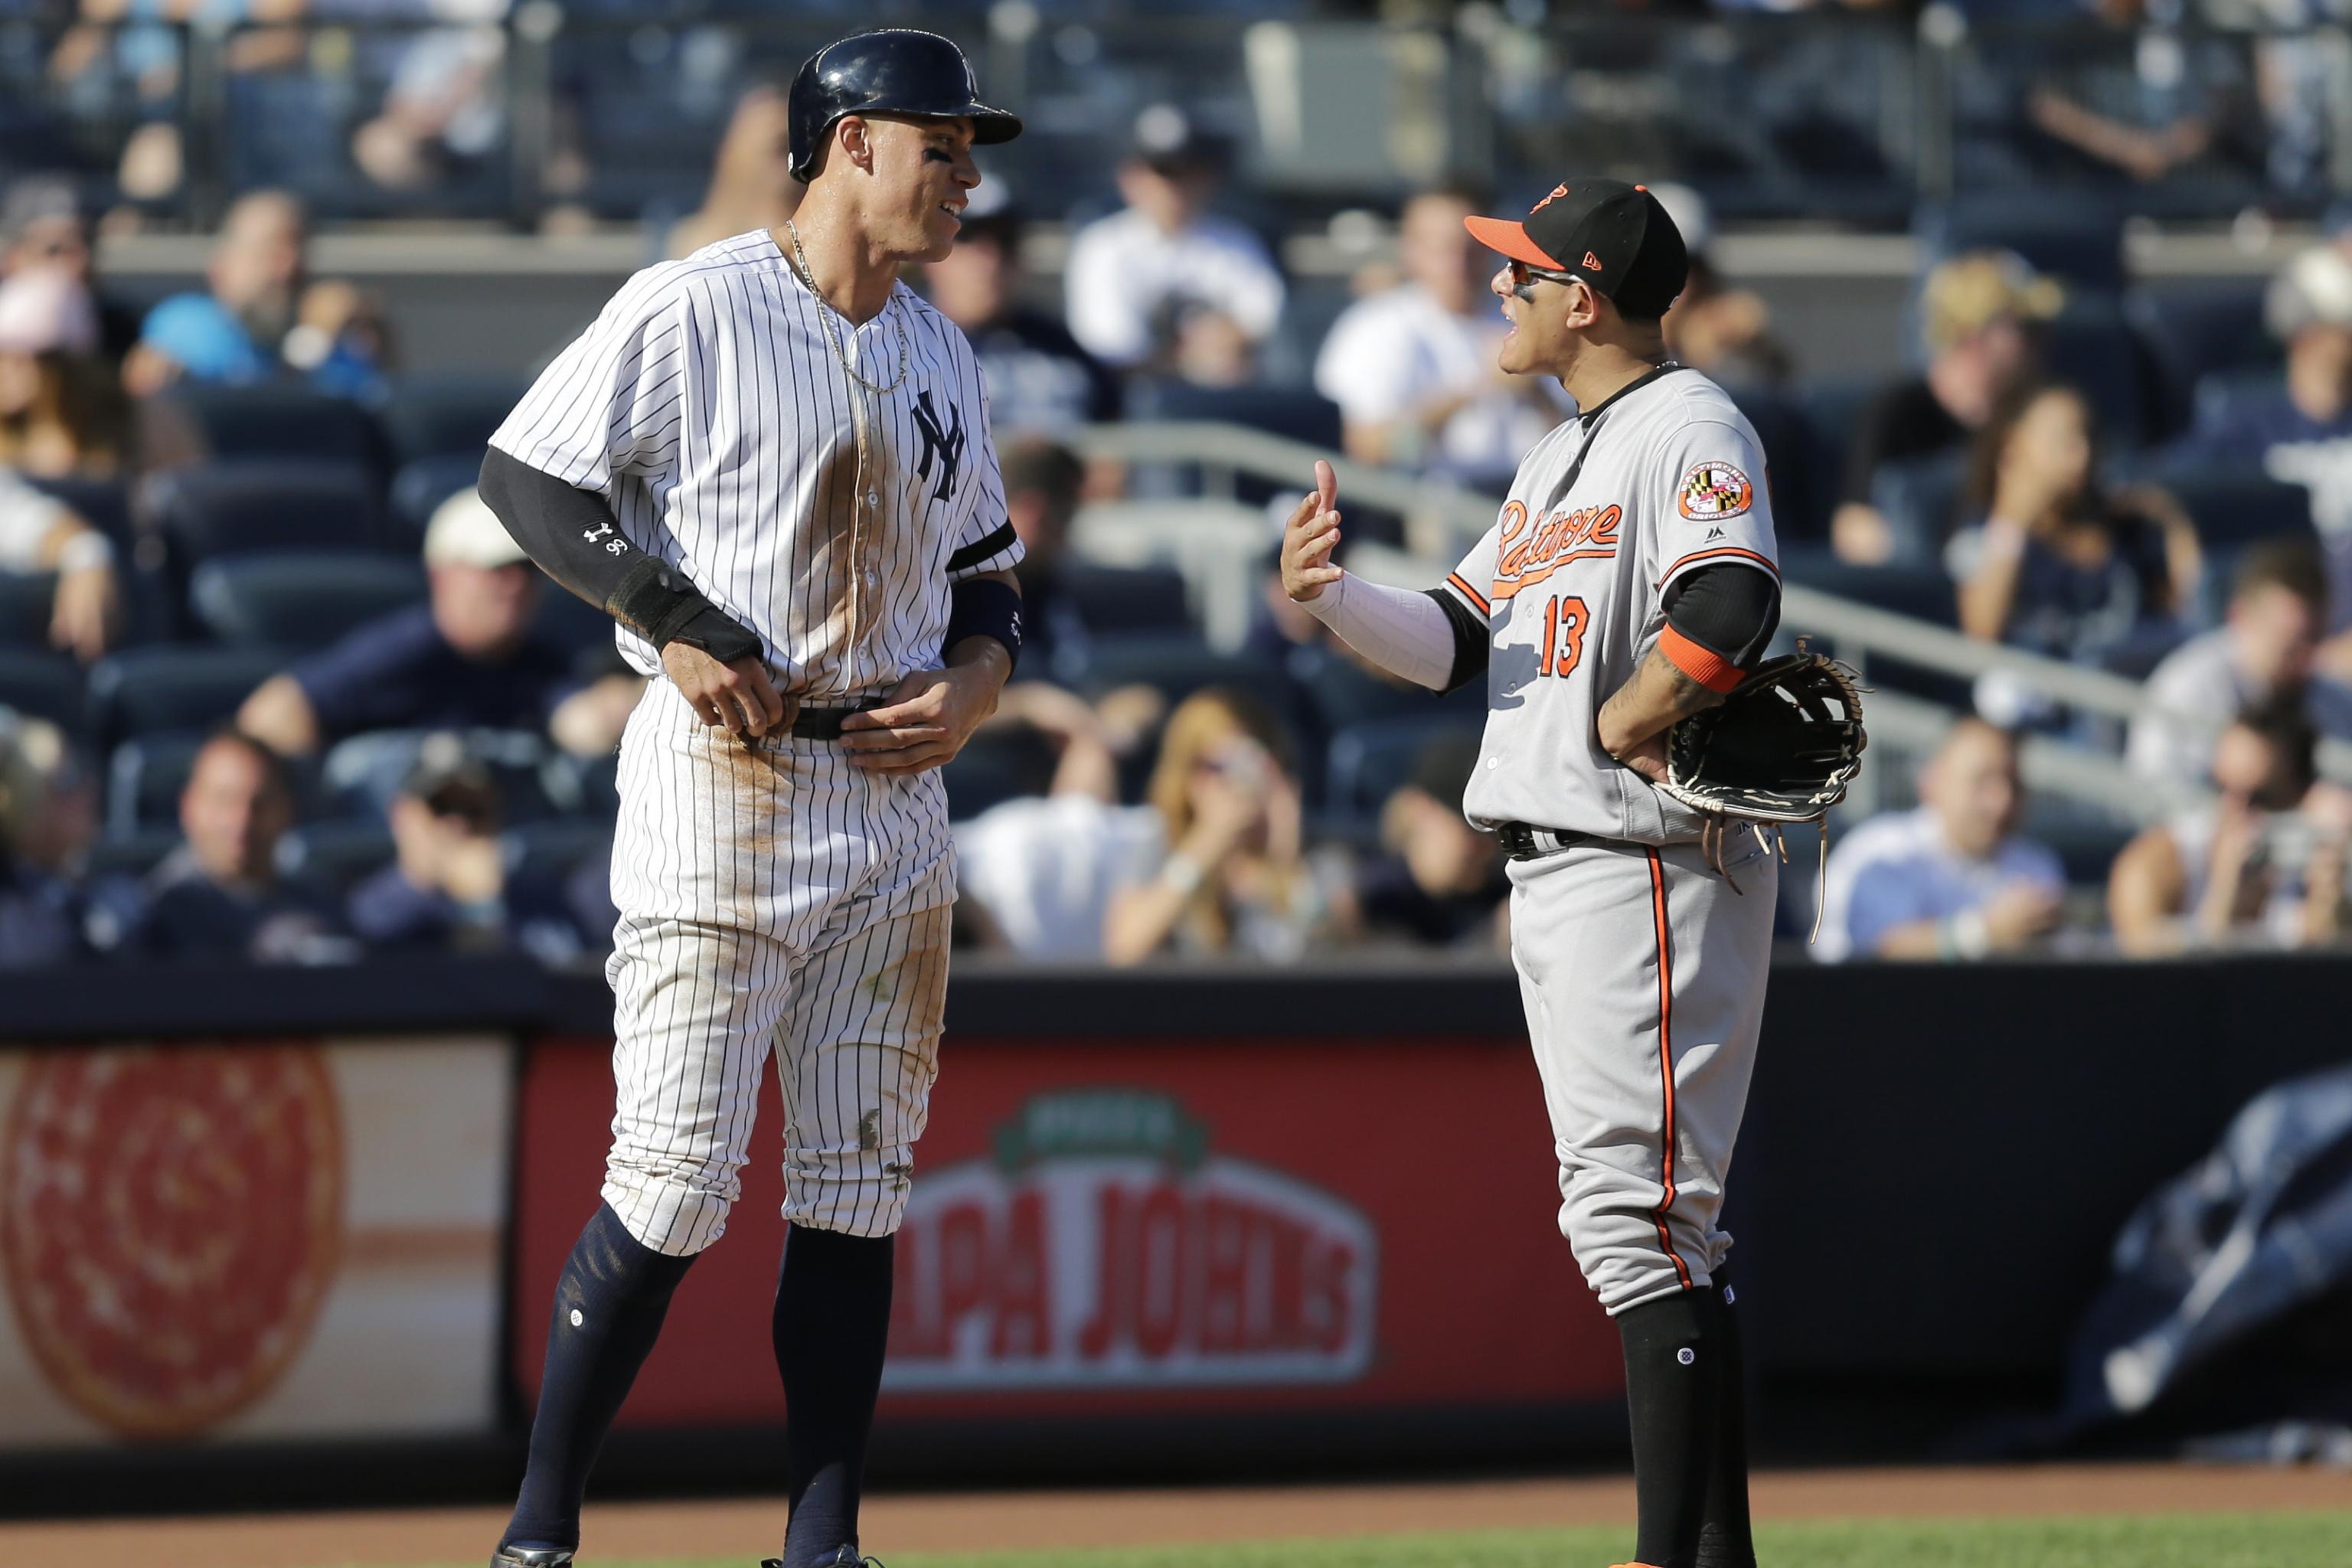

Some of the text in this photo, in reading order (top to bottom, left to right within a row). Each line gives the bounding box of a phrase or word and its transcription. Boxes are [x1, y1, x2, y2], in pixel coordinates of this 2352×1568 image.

[912, 390, 965, 502] NY
[606, 538, 628, 557] 99
[1540, 594, 1590, 679] 13
